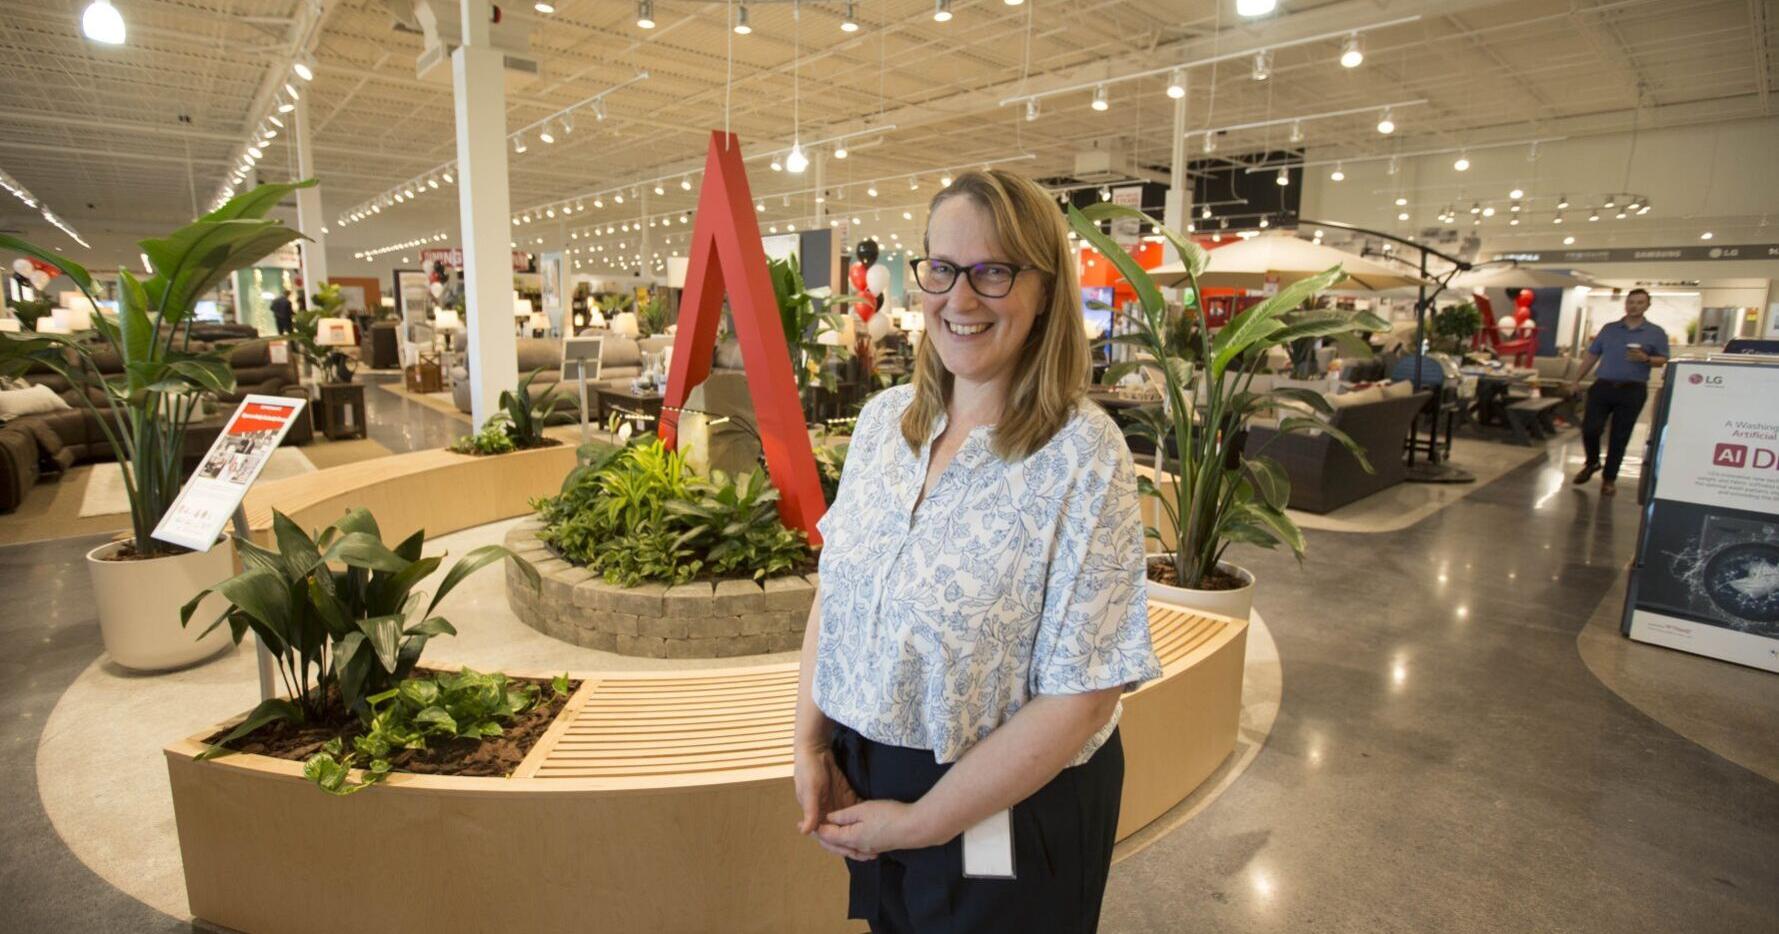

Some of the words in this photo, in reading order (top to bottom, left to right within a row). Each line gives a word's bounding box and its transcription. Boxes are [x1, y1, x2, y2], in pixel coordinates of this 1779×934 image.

[1705, 375, 1723, 385] LG
[1724, 419, 1733, 428] A
[1732, 430, 1777, 441] Artificial
[1718, 448, 1742, 464] AI
[1752, 447, 1779, 471] D
